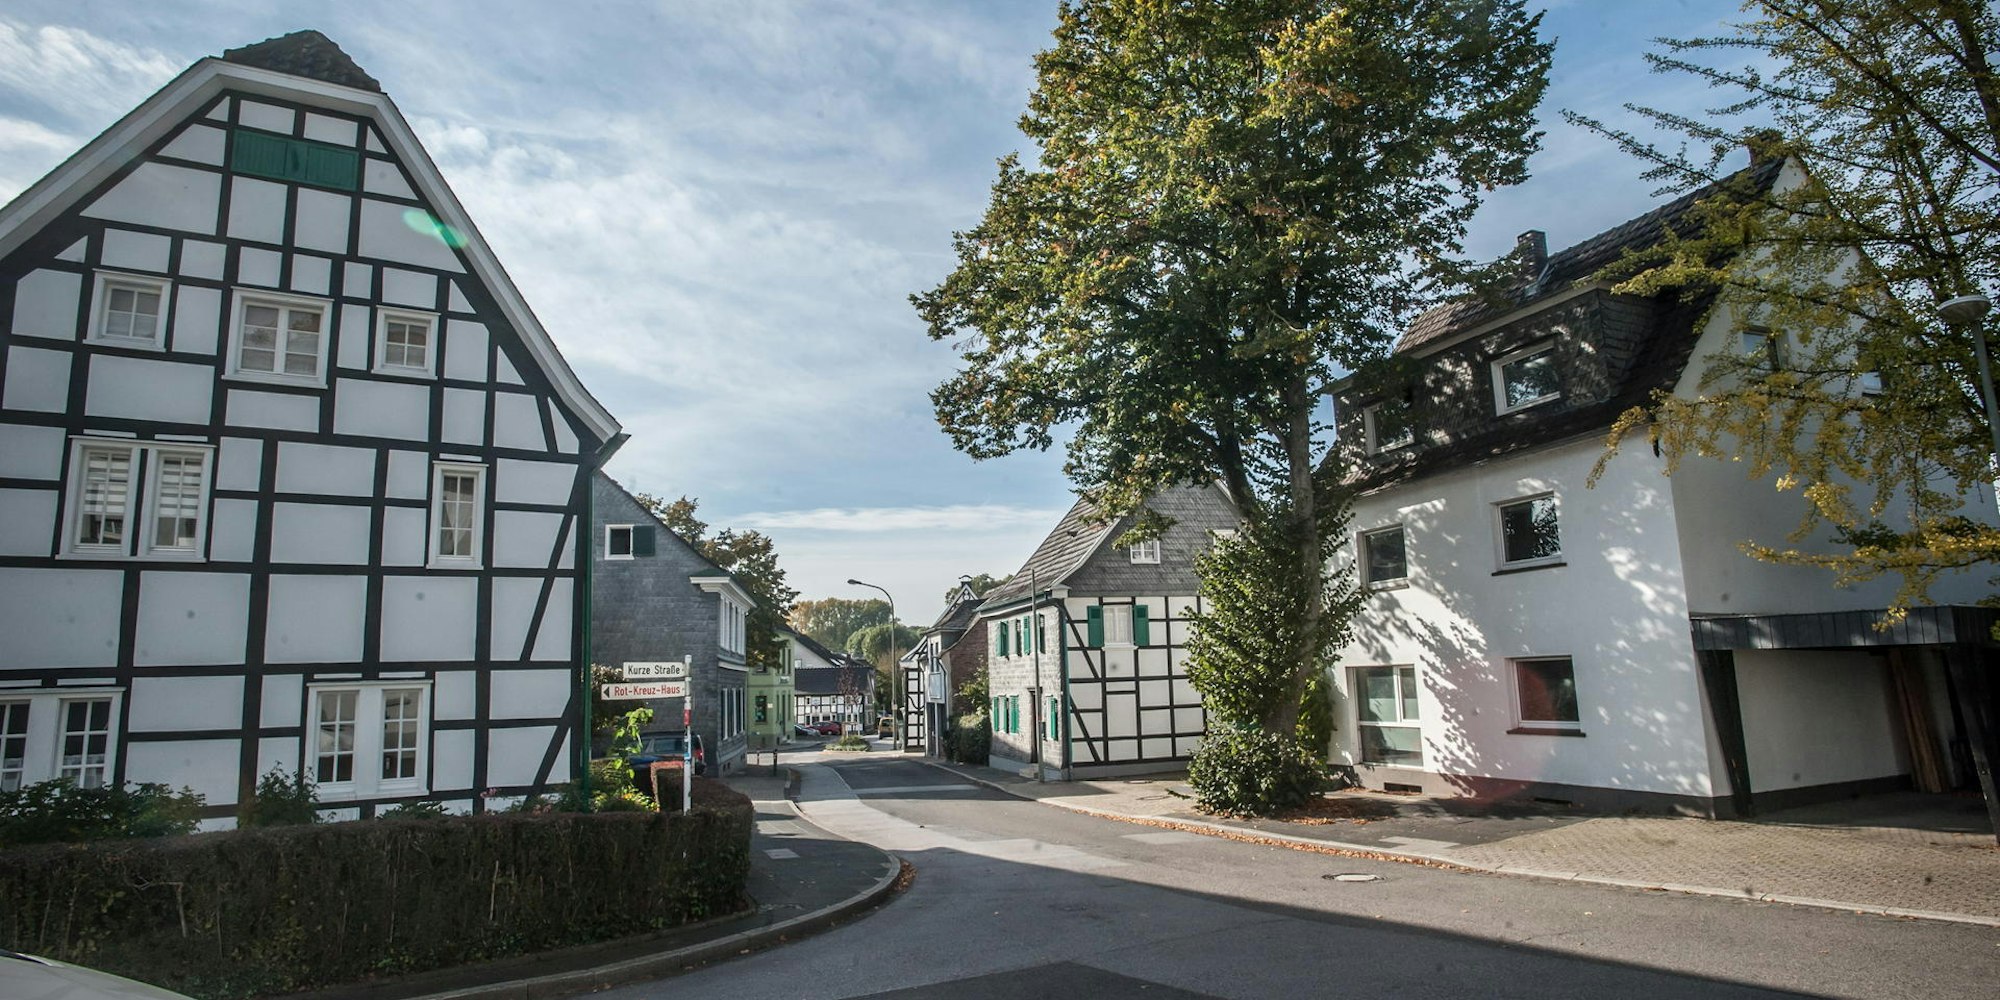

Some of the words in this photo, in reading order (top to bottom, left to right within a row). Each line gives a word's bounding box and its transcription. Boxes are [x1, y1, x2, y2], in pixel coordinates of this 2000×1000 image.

[628, 665, 651, 675] Kurze
[654, 665, 680, 675] Straße
[614, 685, 680, 696] Rot-Kreuz-Haus
